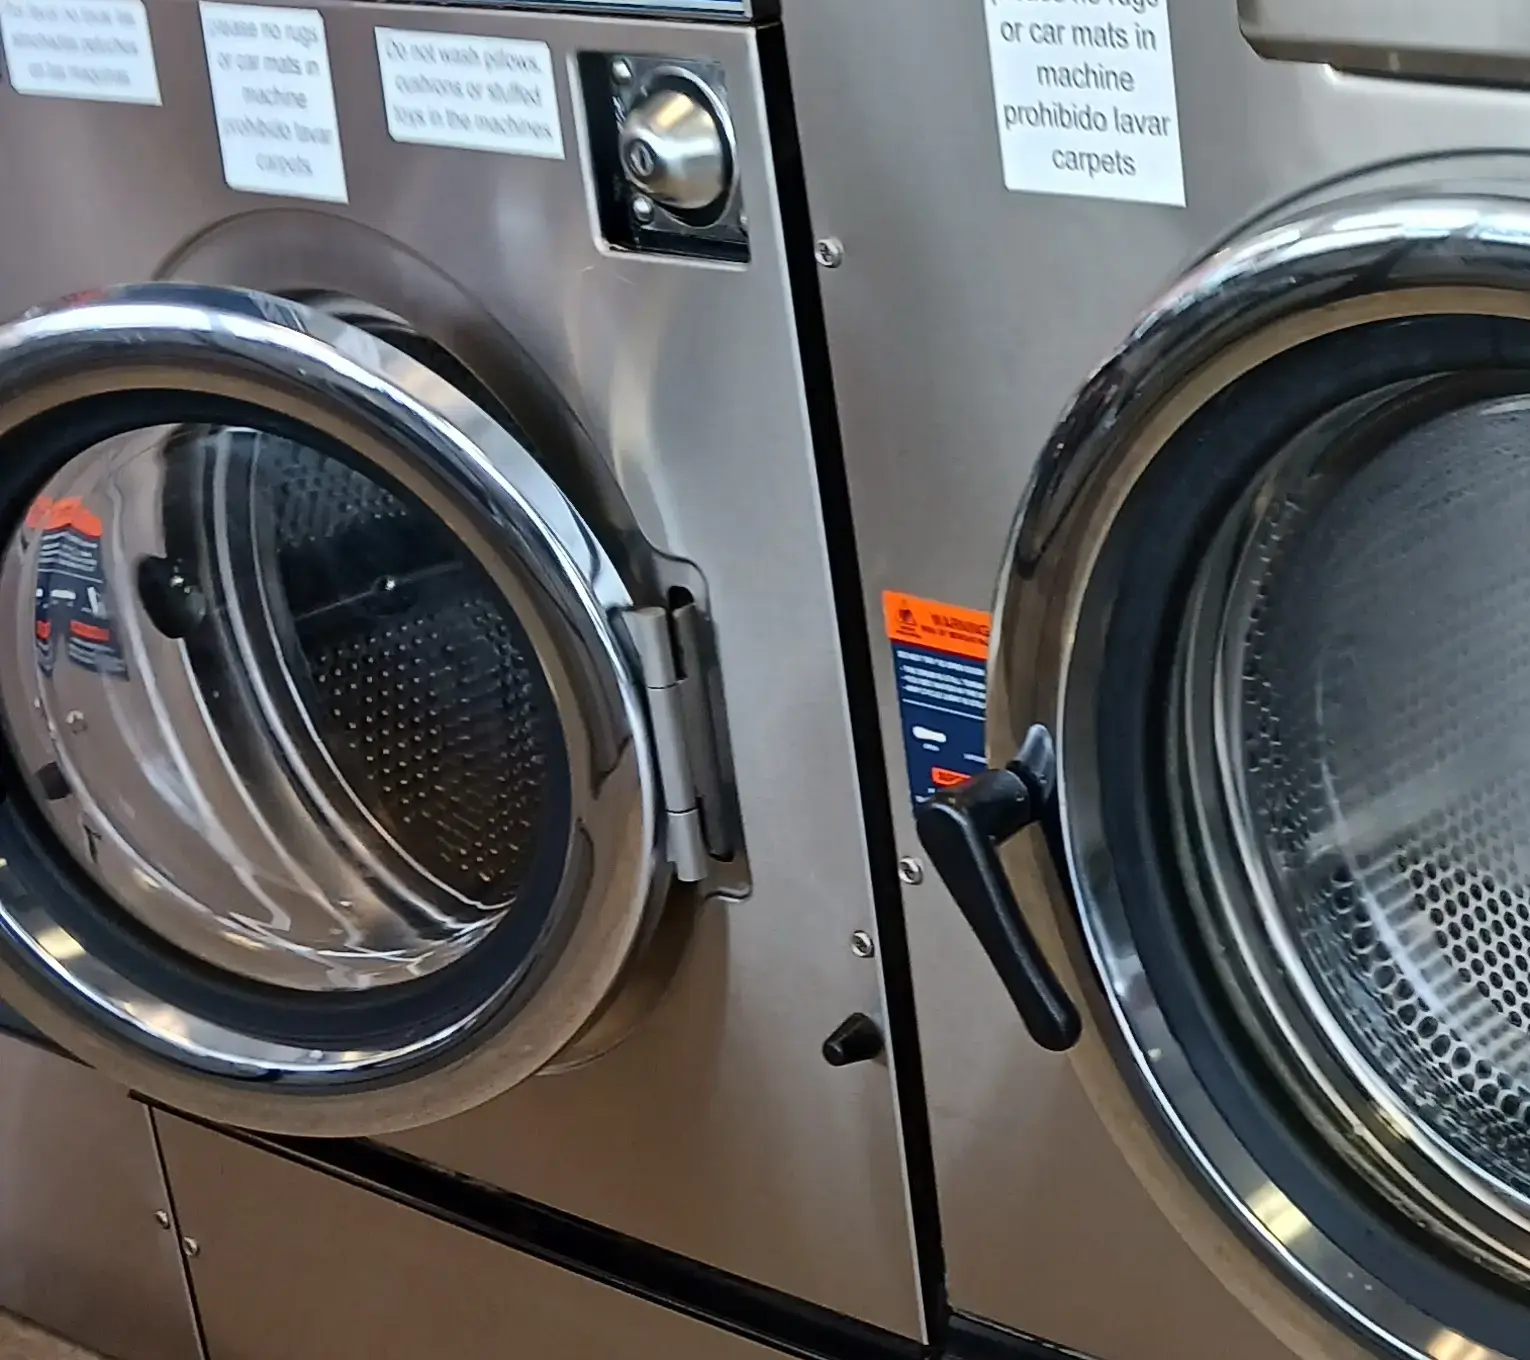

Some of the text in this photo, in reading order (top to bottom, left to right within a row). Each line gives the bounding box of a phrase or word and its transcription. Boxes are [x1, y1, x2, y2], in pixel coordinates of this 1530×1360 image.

[1000, 20, 1158, 51] or car mats in
[1037, 61, 1135, 92] machine
[1004, 100, 1172, 137] prohibido lavar
[1052, 146, 1136, 178] carpets
